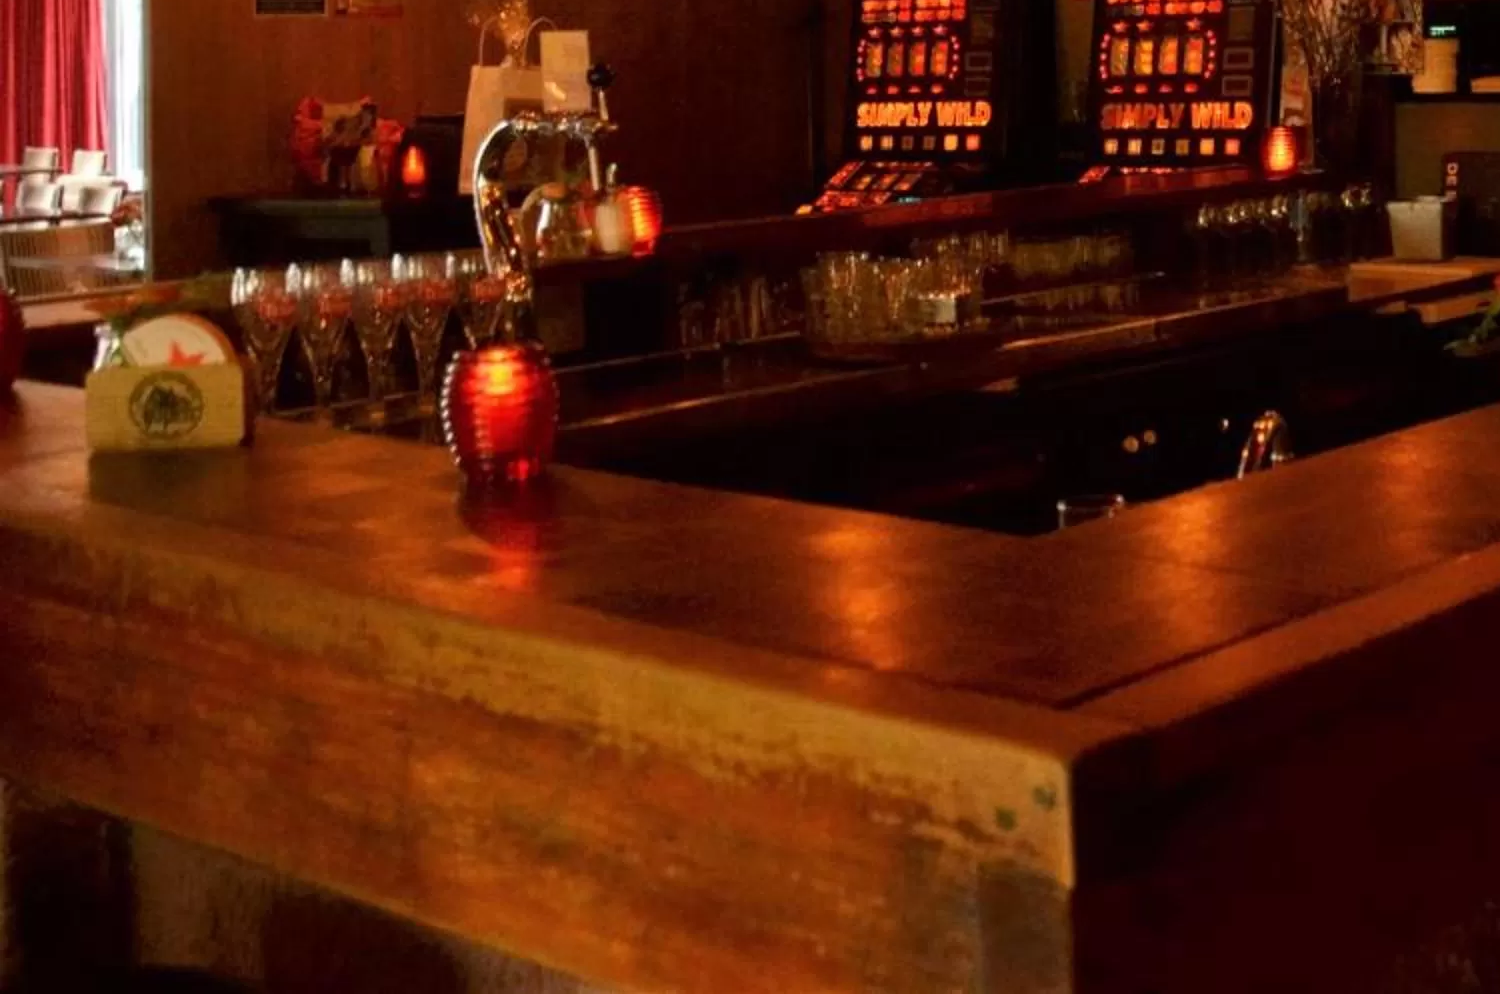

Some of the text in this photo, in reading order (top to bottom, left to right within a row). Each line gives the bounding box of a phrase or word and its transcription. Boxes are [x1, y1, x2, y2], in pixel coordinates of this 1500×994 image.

[857, 101, 992, 127] SIMPLY WILD
[1101, 101, 1253, 129] SIMPLY WILD
